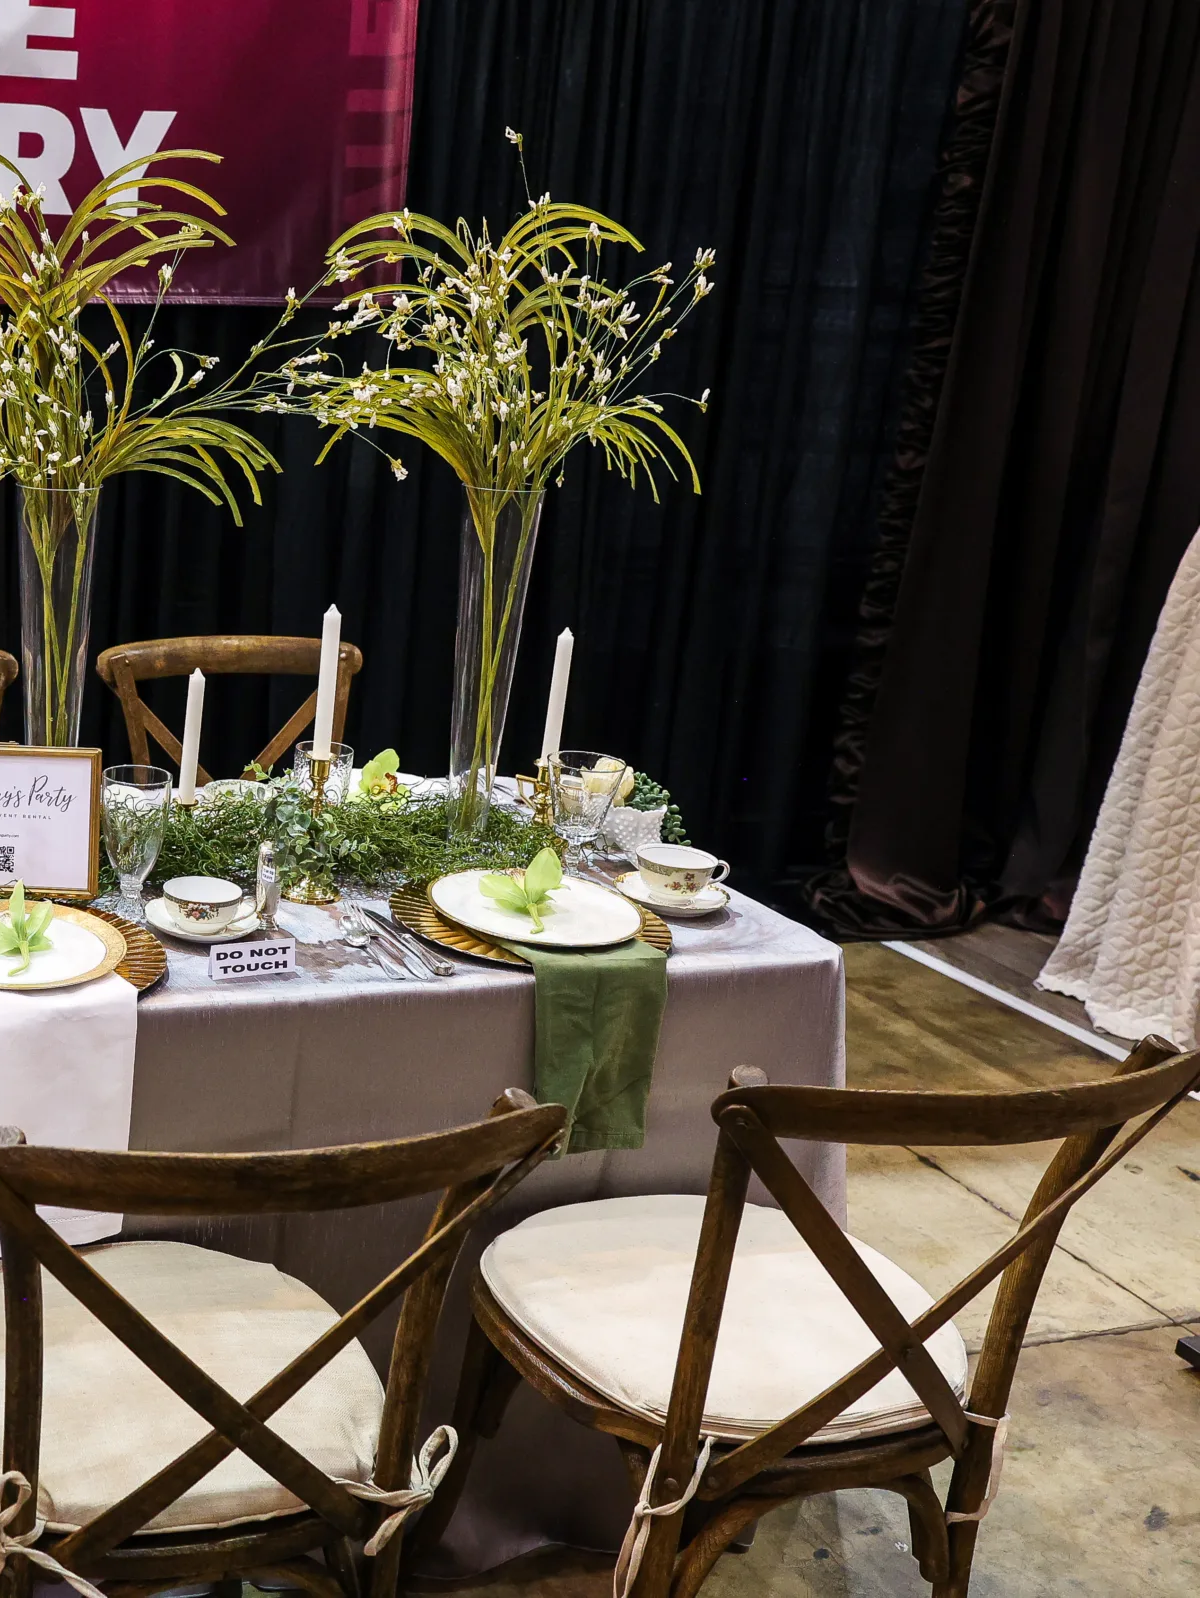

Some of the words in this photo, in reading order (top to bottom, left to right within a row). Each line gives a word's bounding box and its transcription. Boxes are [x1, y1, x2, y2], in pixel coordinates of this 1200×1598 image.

[28, 774, 77, 812] Party
[216, 951, 243, 961] DO
[250, 946, 291, 957] NOT
[219, 960, 288, 974] TOUCH
